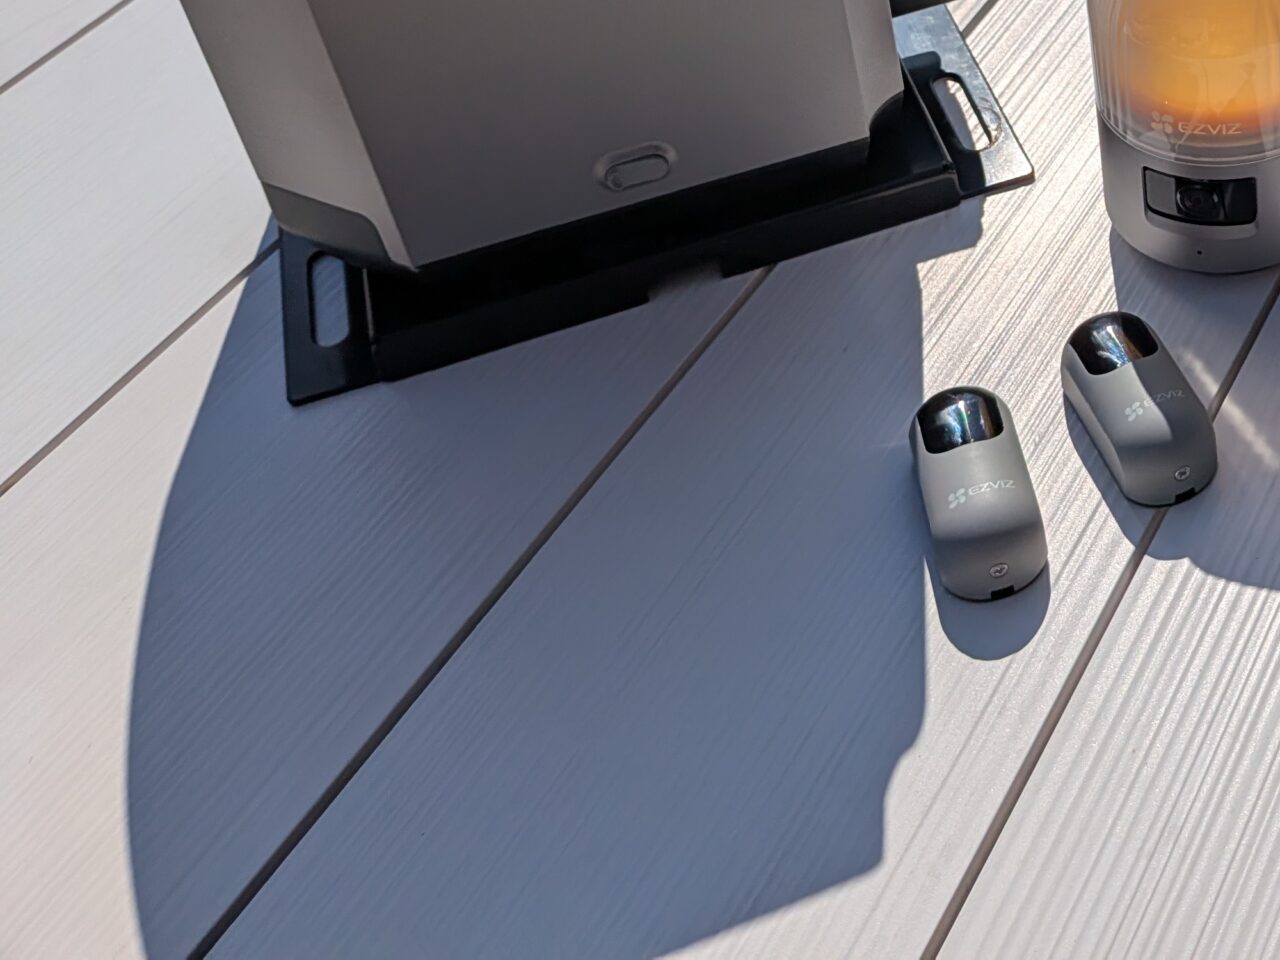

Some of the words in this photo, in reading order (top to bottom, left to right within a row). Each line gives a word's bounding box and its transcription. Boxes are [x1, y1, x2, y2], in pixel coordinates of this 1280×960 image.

[1177, 121, 1242, 135] EZVIZ
[1143, 389, 1186, 408] EZVIZ
[968, 478, 1017, 497] EZVIZ
